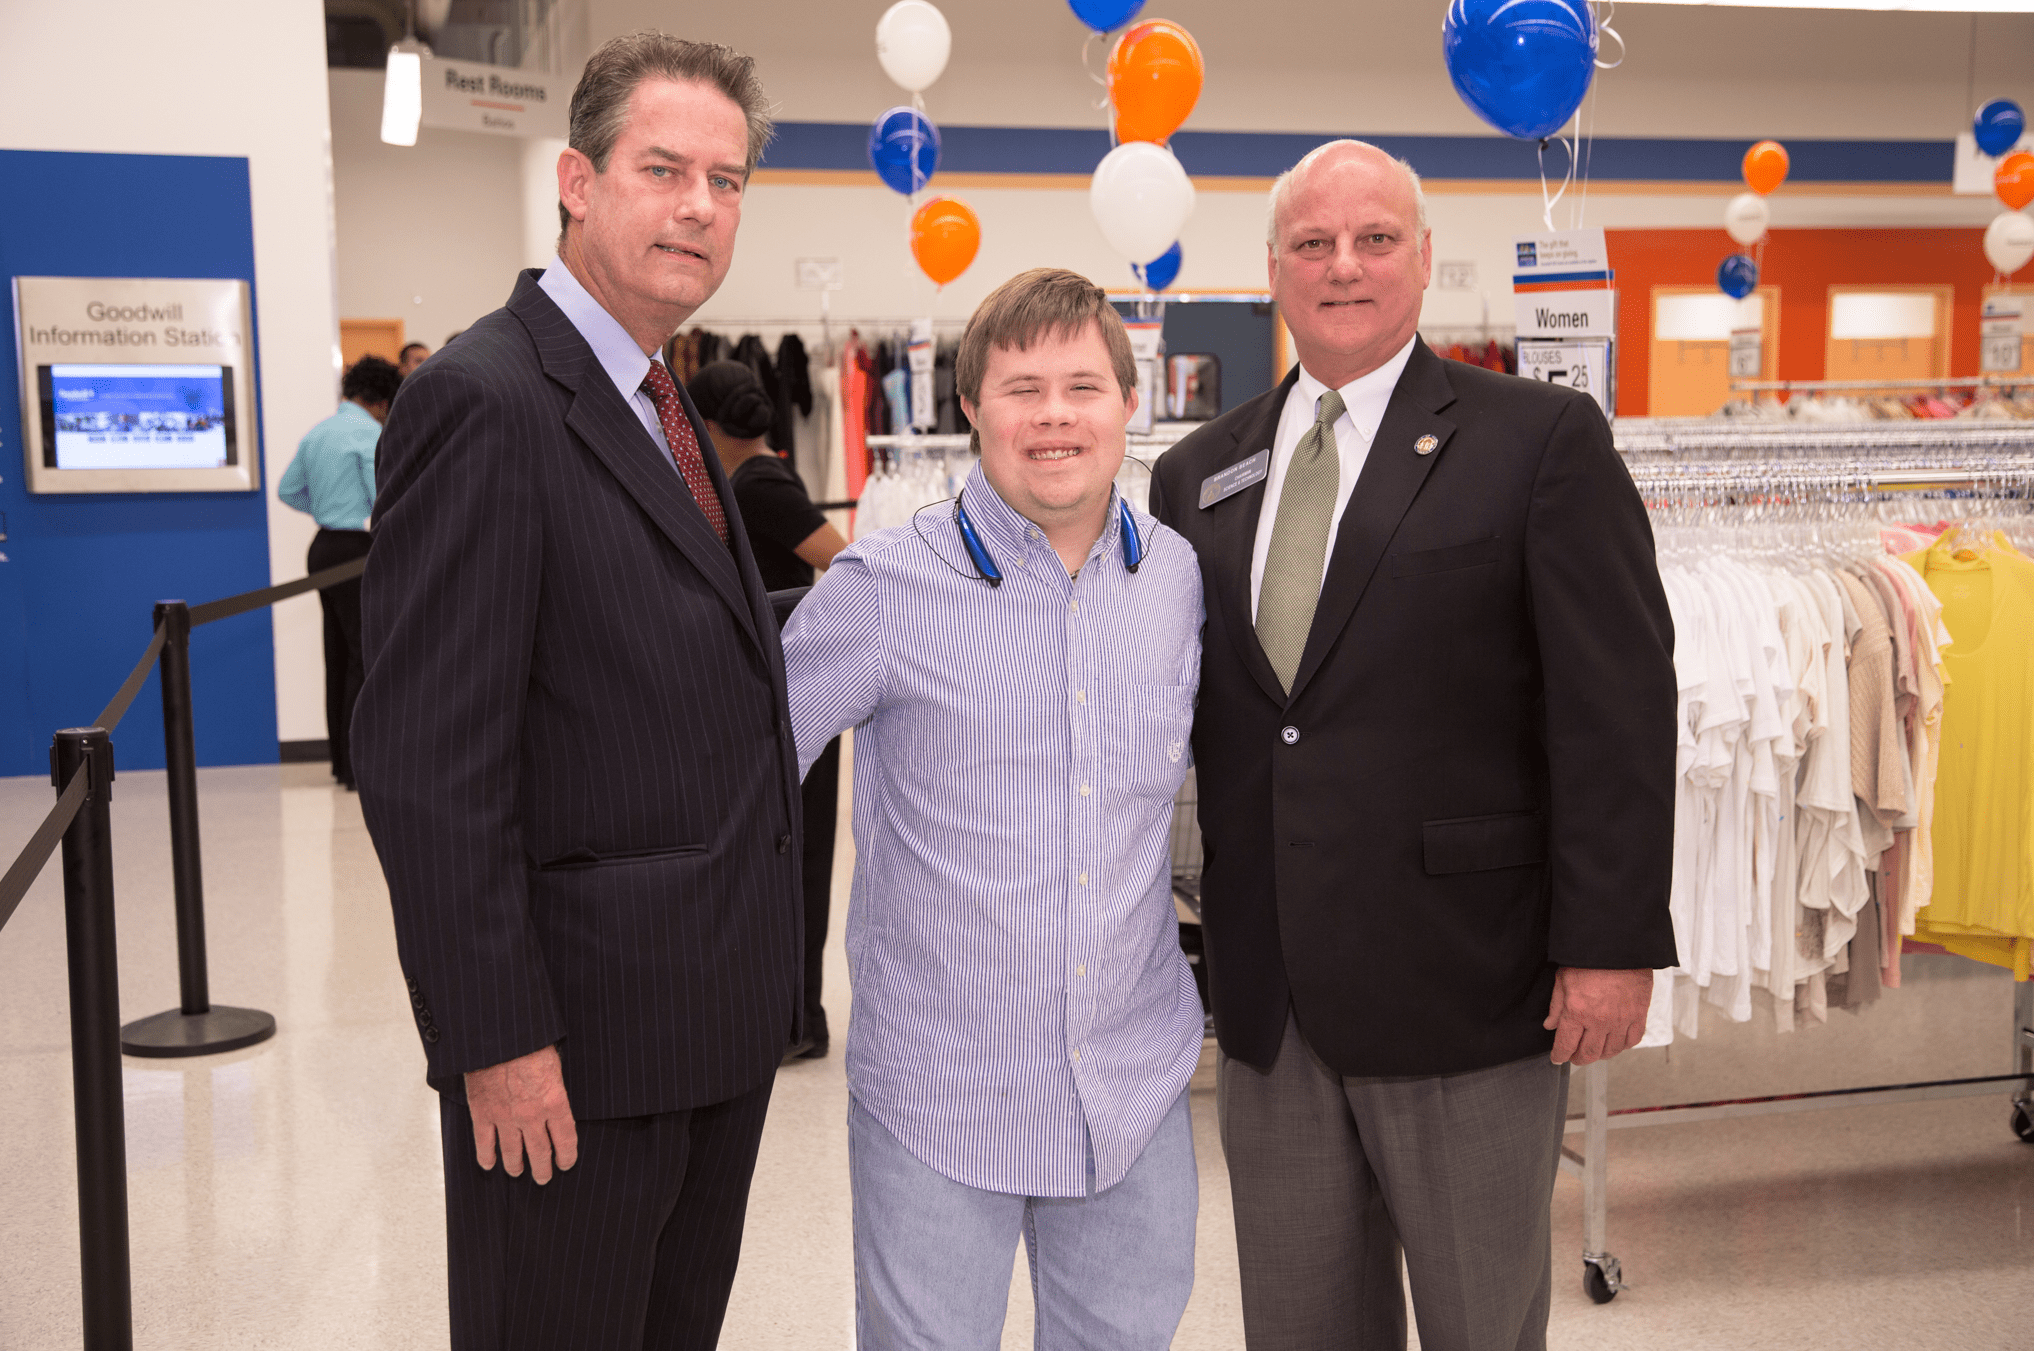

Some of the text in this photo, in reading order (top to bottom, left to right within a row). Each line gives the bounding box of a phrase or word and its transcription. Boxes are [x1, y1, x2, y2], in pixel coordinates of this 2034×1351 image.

[445, 68, 547, 102] Rest Rooms
[86, 301, 183, 322] Goodwill
[1535, 308, 1589, 329] Women
[29, 326, 241, 347] Information Station
[1523, 350, 1562, 365] BLOUSES
[1213, 457, 1256, 482] BRANDON BEACH
